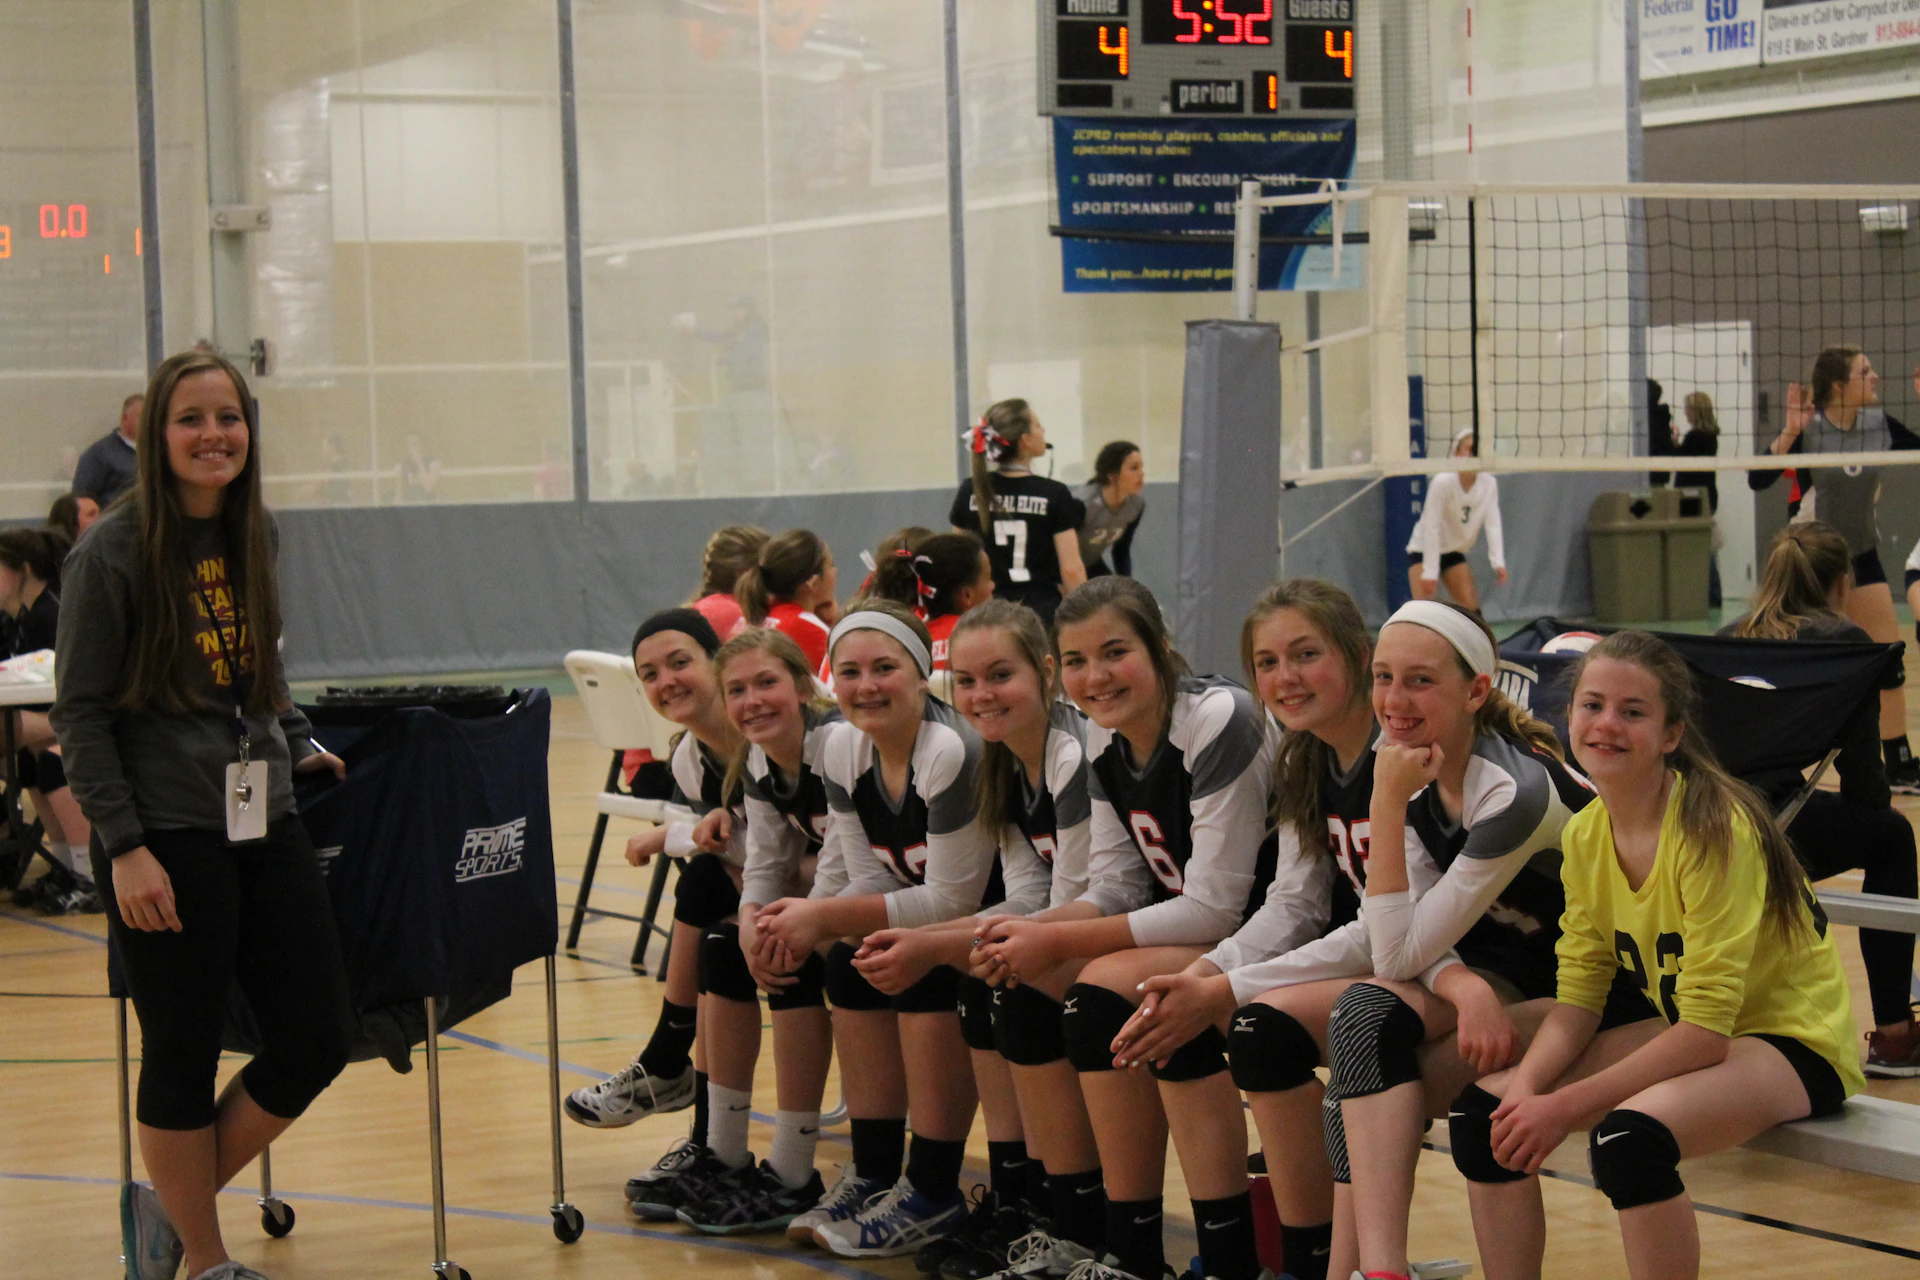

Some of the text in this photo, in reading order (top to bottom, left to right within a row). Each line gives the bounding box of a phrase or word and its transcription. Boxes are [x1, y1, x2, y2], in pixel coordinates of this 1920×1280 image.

[1173, 0, 1273, 44] 5:52
[1705, 0, 1738, 22] GO
[1098, 26, 1128, 76] 4
[1705, 20, 1755, 53] TIME!
[1324, 29, 1353, 79] 4
[1179, 81, 1238, 109] period
[1268, 75, 1278, 110] 1
[1087, 173, 1153, 187] SUPPORT
[40, 204, 88, 239] 0.0
[1072, 201, 1195, 215] SPORTSMANSHIP
[103, 253, 111, 275] 1
[1076, 267, 1108, 279] Thank
[1182, 268, 1212, 281] great
[1017, 495, 1049, 516] ELITE
[1460, 506, 1471, 524] 3
[993, 520, 1031, 583] 7
[455, 846, 523, 879] SPORTS
[1129, 809, 1183, 894] 6
